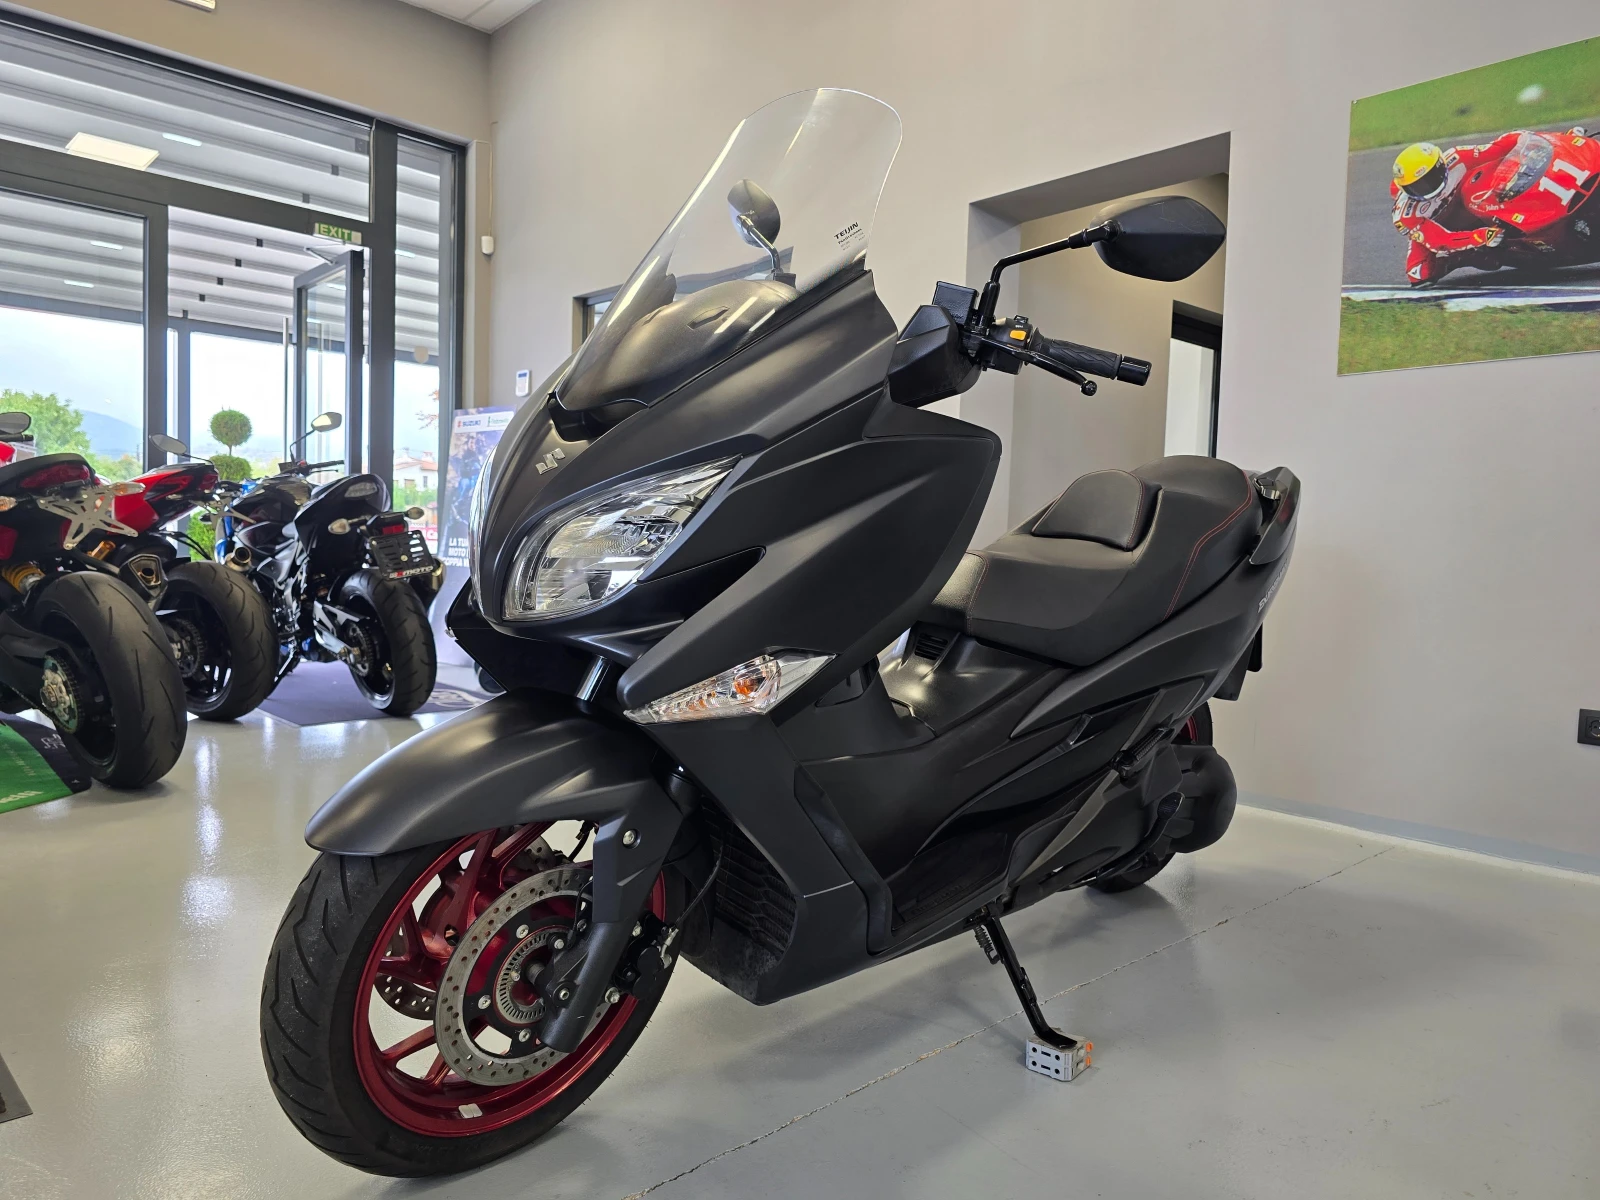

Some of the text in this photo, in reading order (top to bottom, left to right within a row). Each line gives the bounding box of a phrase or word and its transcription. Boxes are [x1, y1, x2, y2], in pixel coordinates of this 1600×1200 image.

[1538, 158, 1591, 206] 11
[320, 224, 351, 241] EXIT
[834, 221, 859, 239] TEIJIN
[449, 538, 457, 546] LA
[448, 547, 466, 557] MOTO
